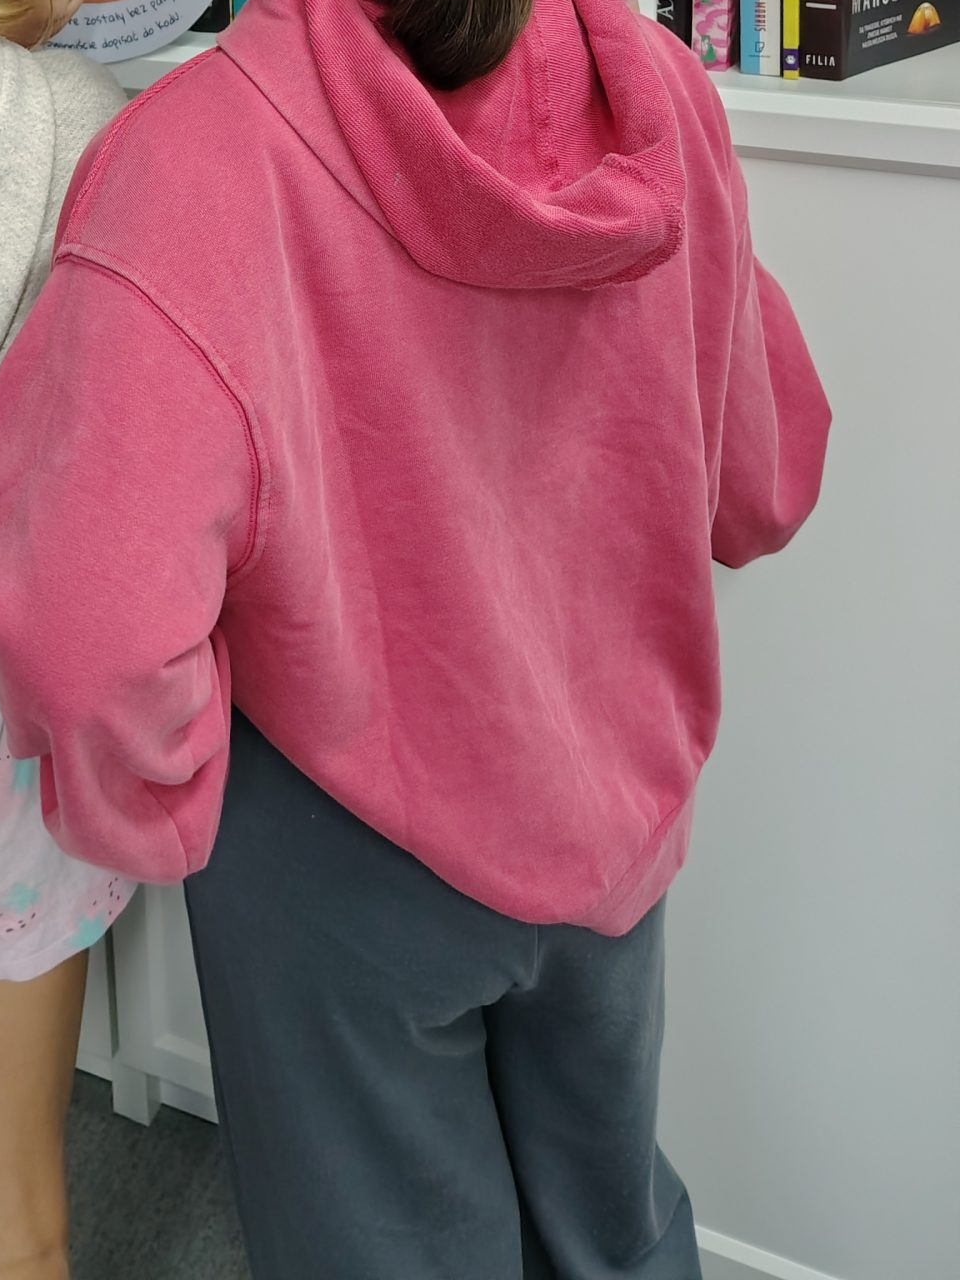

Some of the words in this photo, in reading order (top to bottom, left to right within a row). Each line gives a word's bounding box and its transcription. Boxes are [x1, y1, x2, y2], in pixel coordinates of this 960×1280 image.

[126, 4, 148, 18] bez
[754, 0, 767, 32] MORRIS
[143, 27, 155, 39] do
[806, 54, 836, 67] FILIA
